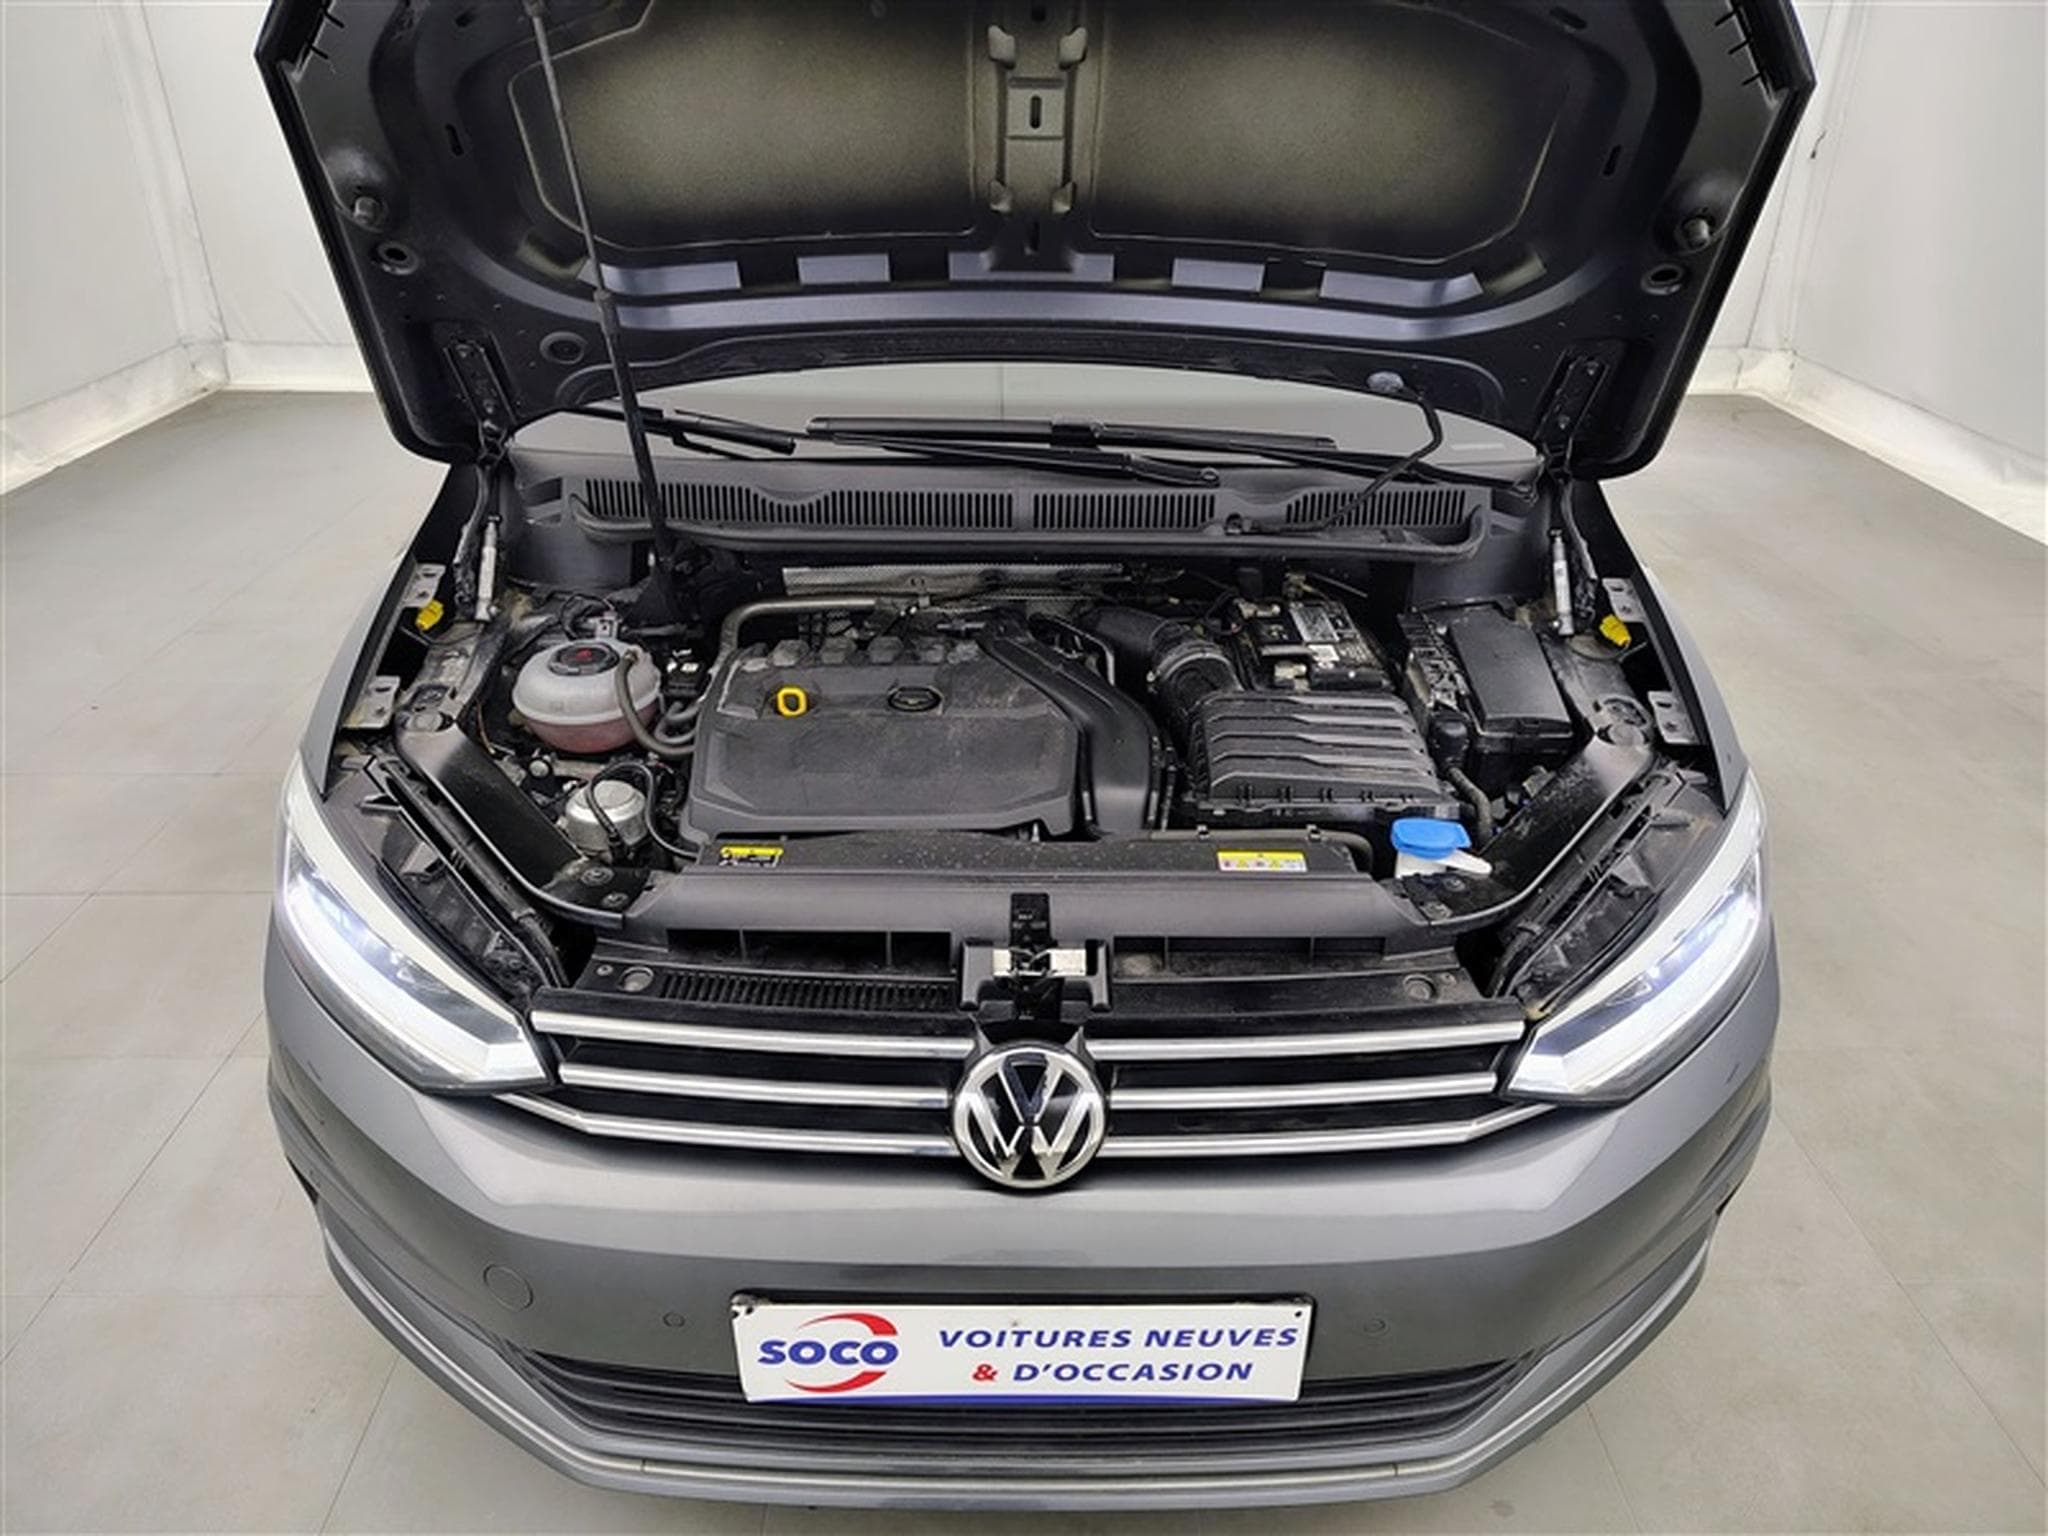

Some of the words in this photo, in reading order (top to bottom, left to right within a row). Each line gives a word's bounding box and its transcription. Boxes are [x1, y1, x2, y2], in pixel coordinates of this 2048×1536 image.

[939, 1329, 1131, 1349] VOITURES
[1144, 1327, 1298, 1348] NEUVES
[757, 1339, 899, 1366] SOCO
[971, 1363, 999, 1383] &
[1013, 1362, 1254, 1382] D'OCCASION
